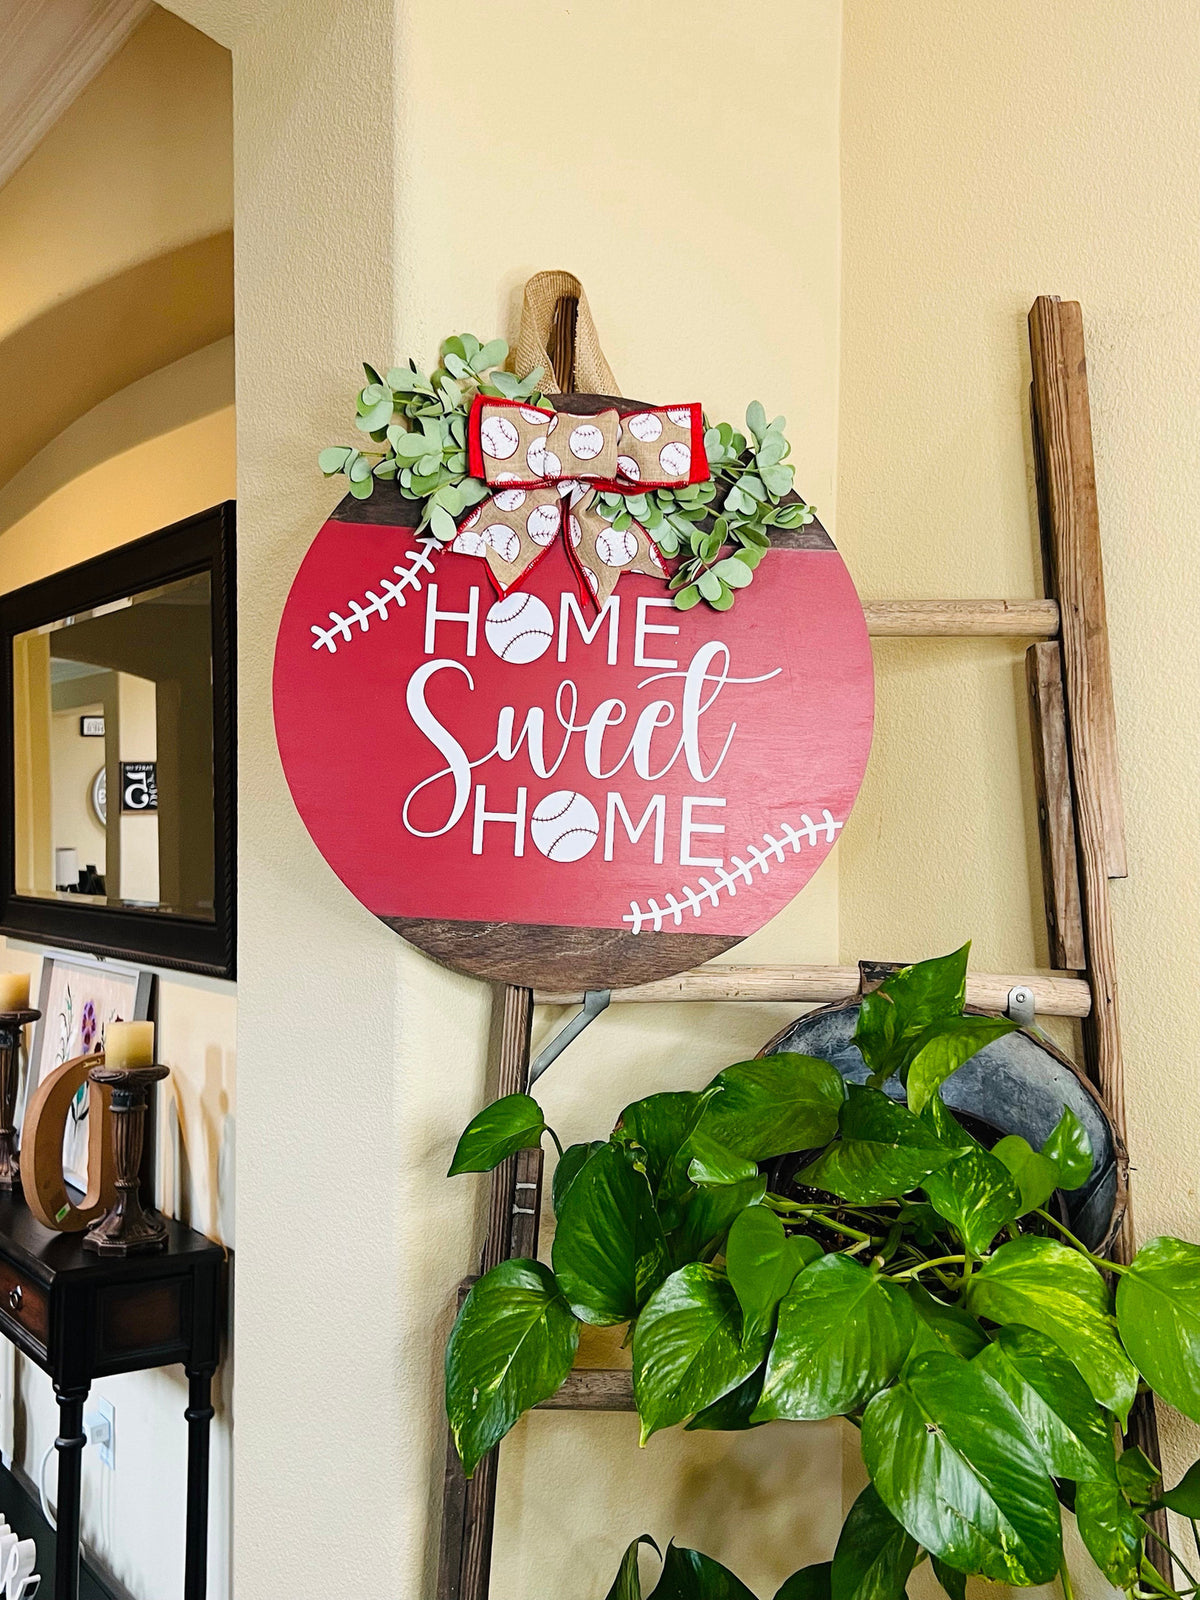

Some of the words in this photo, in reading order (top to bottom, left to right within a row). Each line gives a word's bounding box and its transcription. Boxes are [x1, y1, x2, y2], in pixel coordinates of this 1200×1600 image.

[424, 583, 680, 669] HOME
[402, 640, 783, 837] Sweet
[472, 784, 728, 867] HOME
